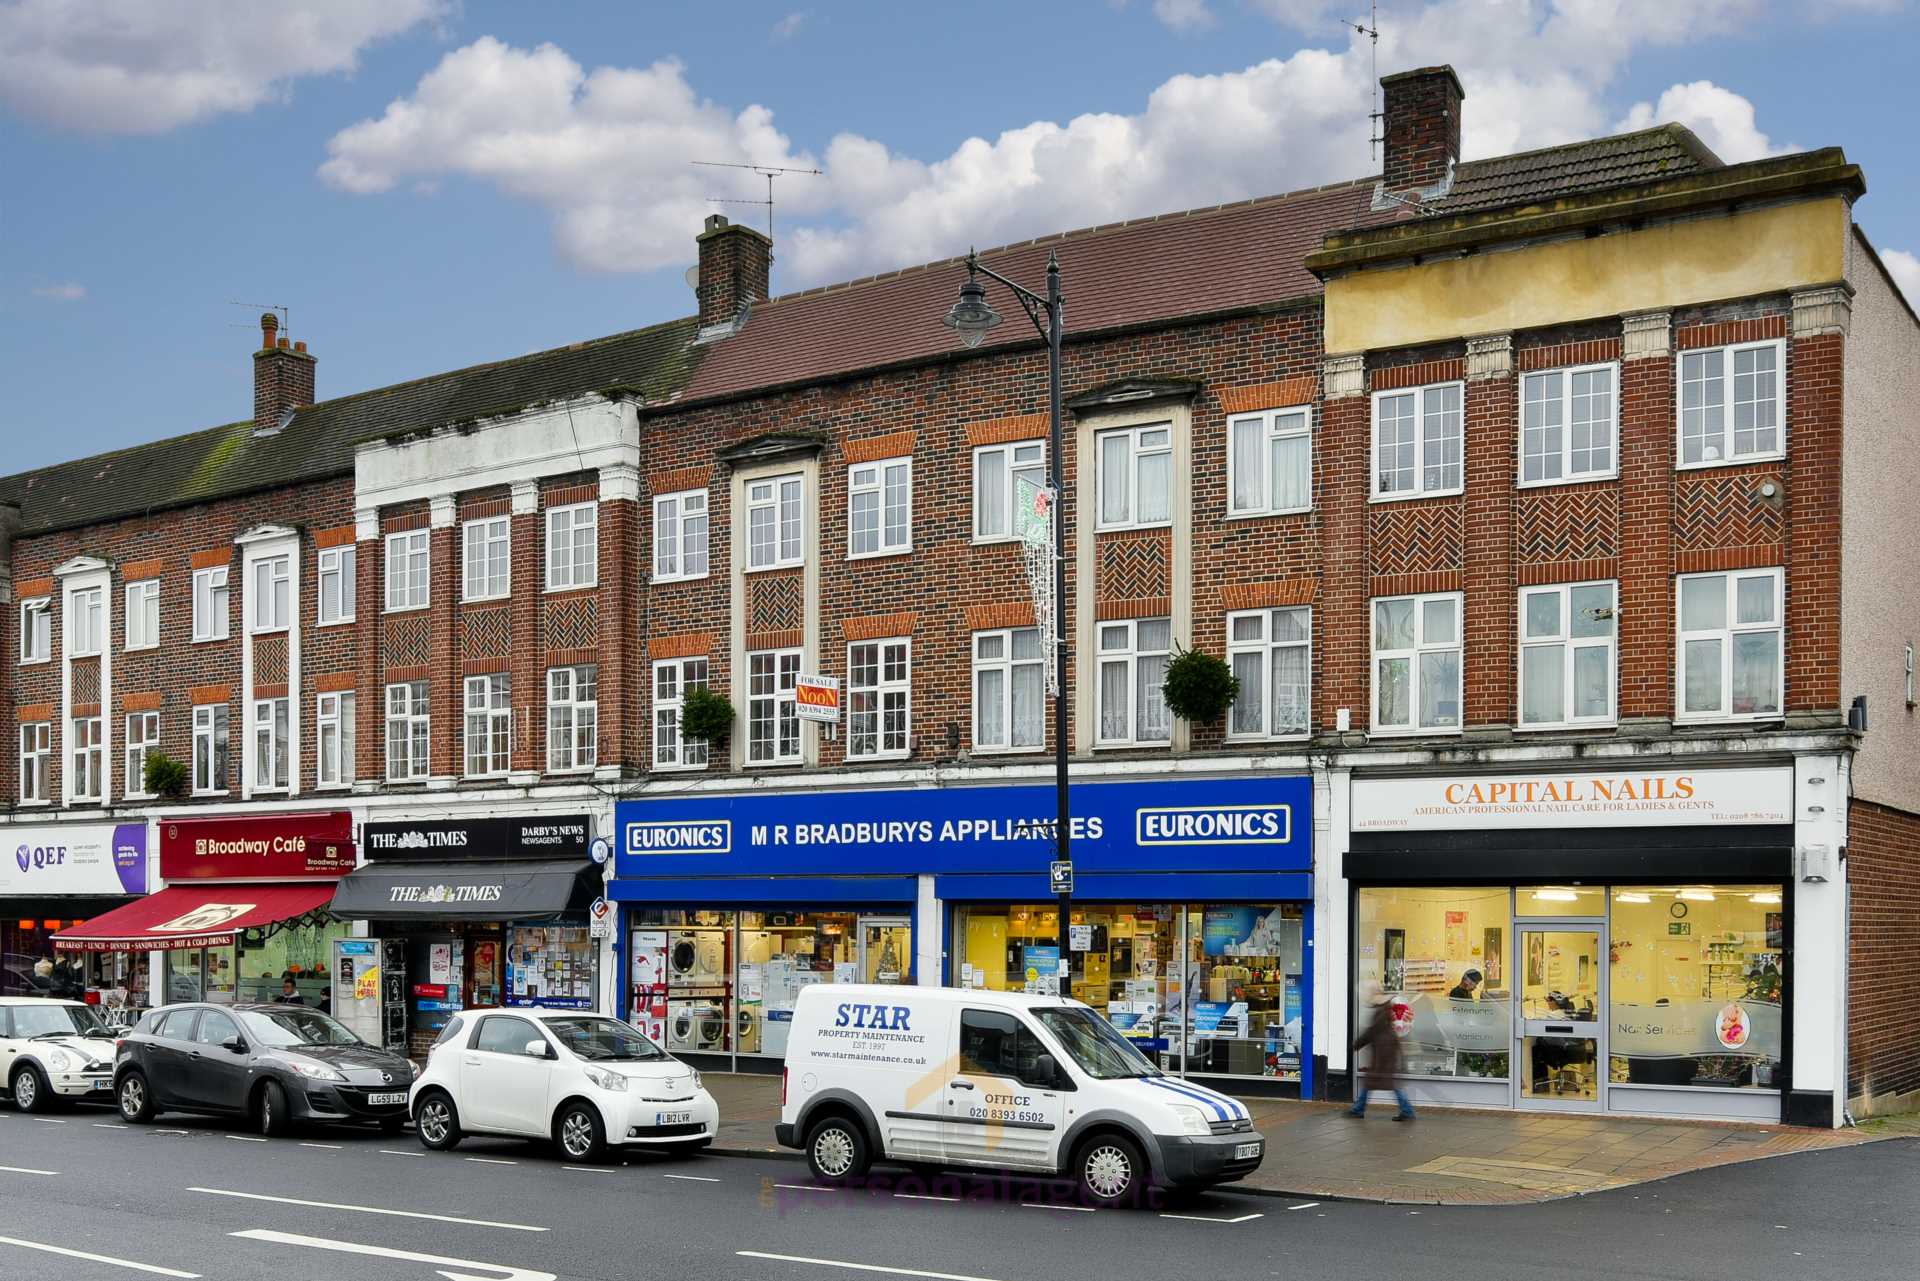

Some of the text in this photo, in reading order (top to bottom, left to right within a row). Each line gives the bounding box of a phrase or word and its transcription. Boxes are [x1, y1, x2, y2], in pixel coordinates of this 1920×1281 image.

[1445, 777, 1694, 804] CAPITAL NAILS
[1414, 800, 1714, 816] AMERICAN PROFESSIONAL NAIL CARE FOR LADIES & GENTS
[1146, 813, 1279, 837] EURONICS
[1368, 818, 1408, 826] BROADWAY
[521, 825, 584, 837] DARBY'S NEWS
[632, 827, 723, 848] EURONICS
[751, 826, 767, 846] M
[775, 825, 788, 845] R
[795, 821, 932, 845] BRADBURYS
[208, 836, 306, 856] Broadway Café
[371, 830, 468, 849] THE TIMES
[521, 835, 584, 845] NEWSAGENTS 50
[33, 846, 67, 869] QEF
[307, 858, 355, 867] Broadway Café
[390, 885, 502, 902] THE TIMES
[56, 941, 83, 949] BREAKFAST
[87, 942, 105, 950] LUNCH
[134, 942, 169, 950] SANDWICHES
[174, 940, 185, 948] HOT
[192, 938, 207, 946] COLD
[208, 936, 230, 946] DRINKS
[357, 979, 376, 988] PLAY
[835, 1003, 911, 1031] STAR
[818, 1029, 925, 1043] PROPERTY MAINTENANCE
[811, 1050, 927, 1065] www.starmaintenance.co.uk
[985, 1094, 1031, 1106] OFFICE
[970, 1107, 1044, 1123] 020 8393 6502
